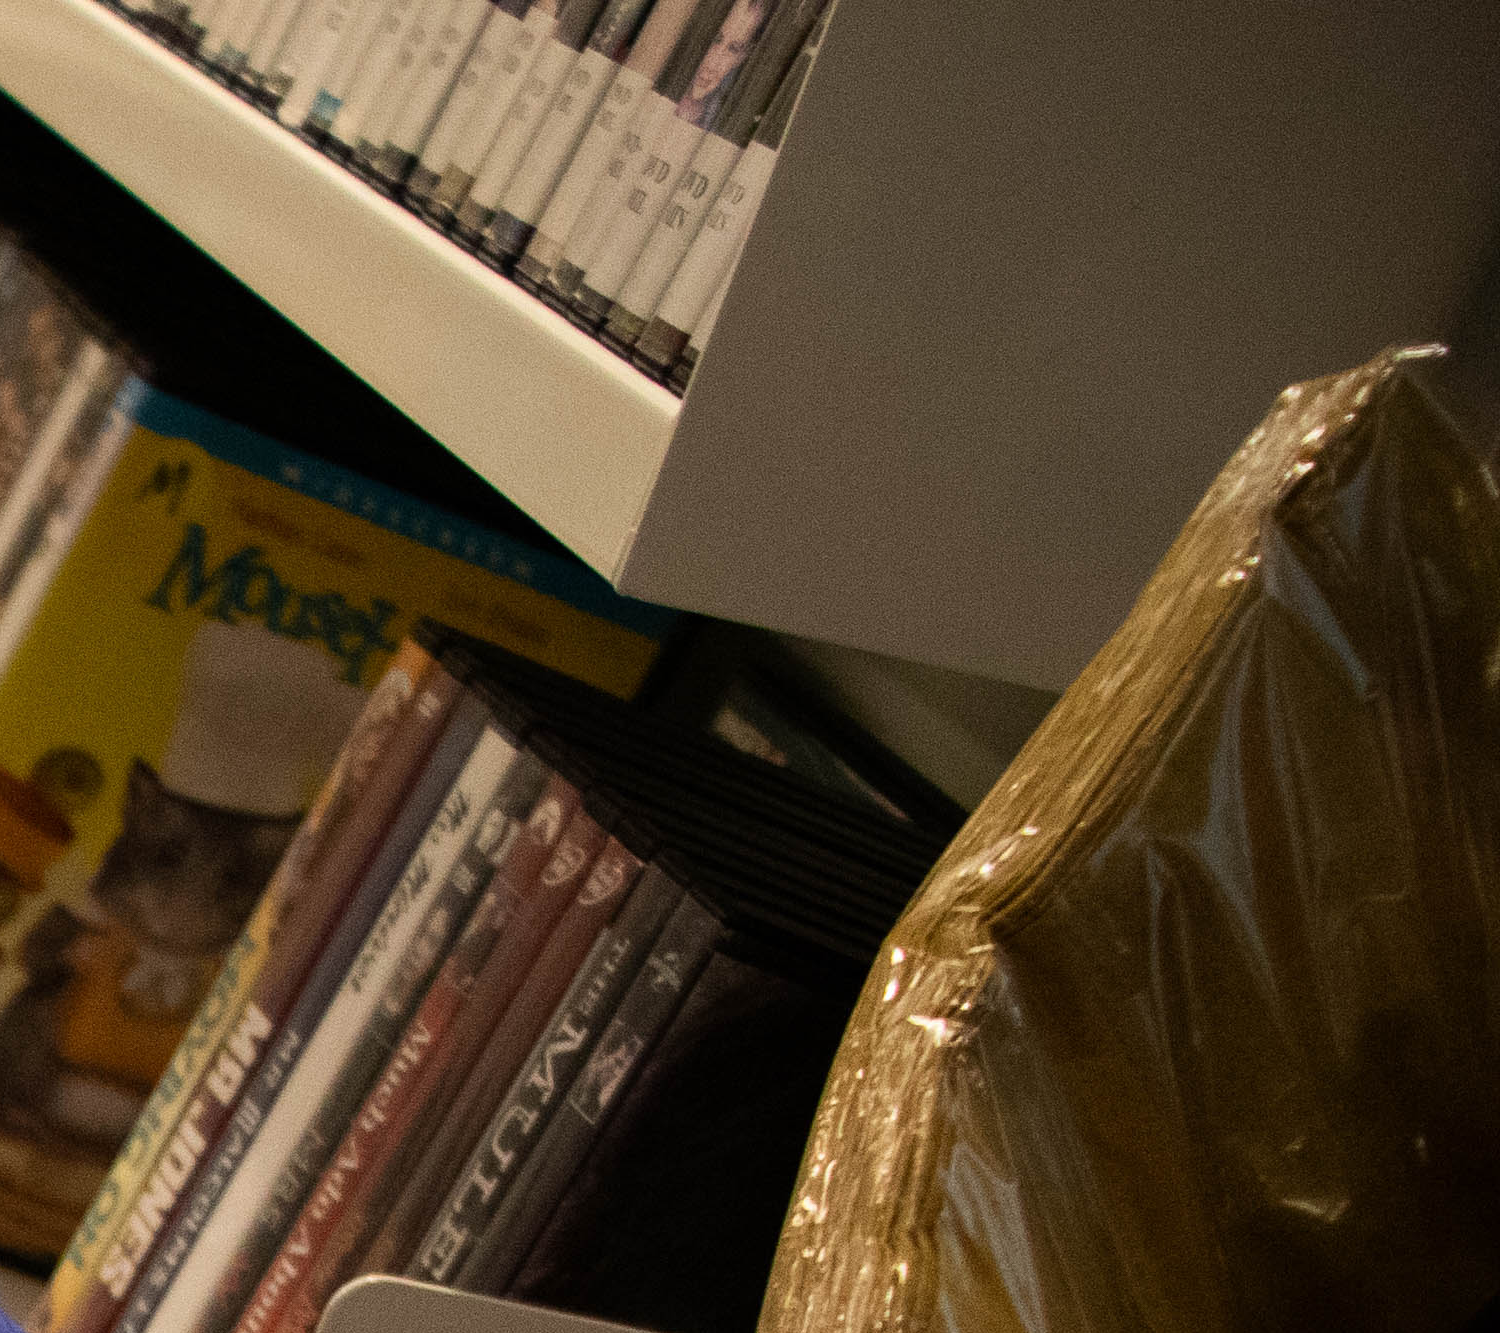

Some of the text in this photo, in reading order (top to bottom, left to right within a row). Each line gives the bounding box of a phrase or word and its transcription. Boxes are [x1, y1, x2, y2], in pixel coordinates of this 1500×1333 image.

[357, 1019, 437, 1138] Much
[414, 1005, 592, 1288] MULE
[89, 1096, 224, 1303] JONES
[304, 1134, 369, 1225] Ado
